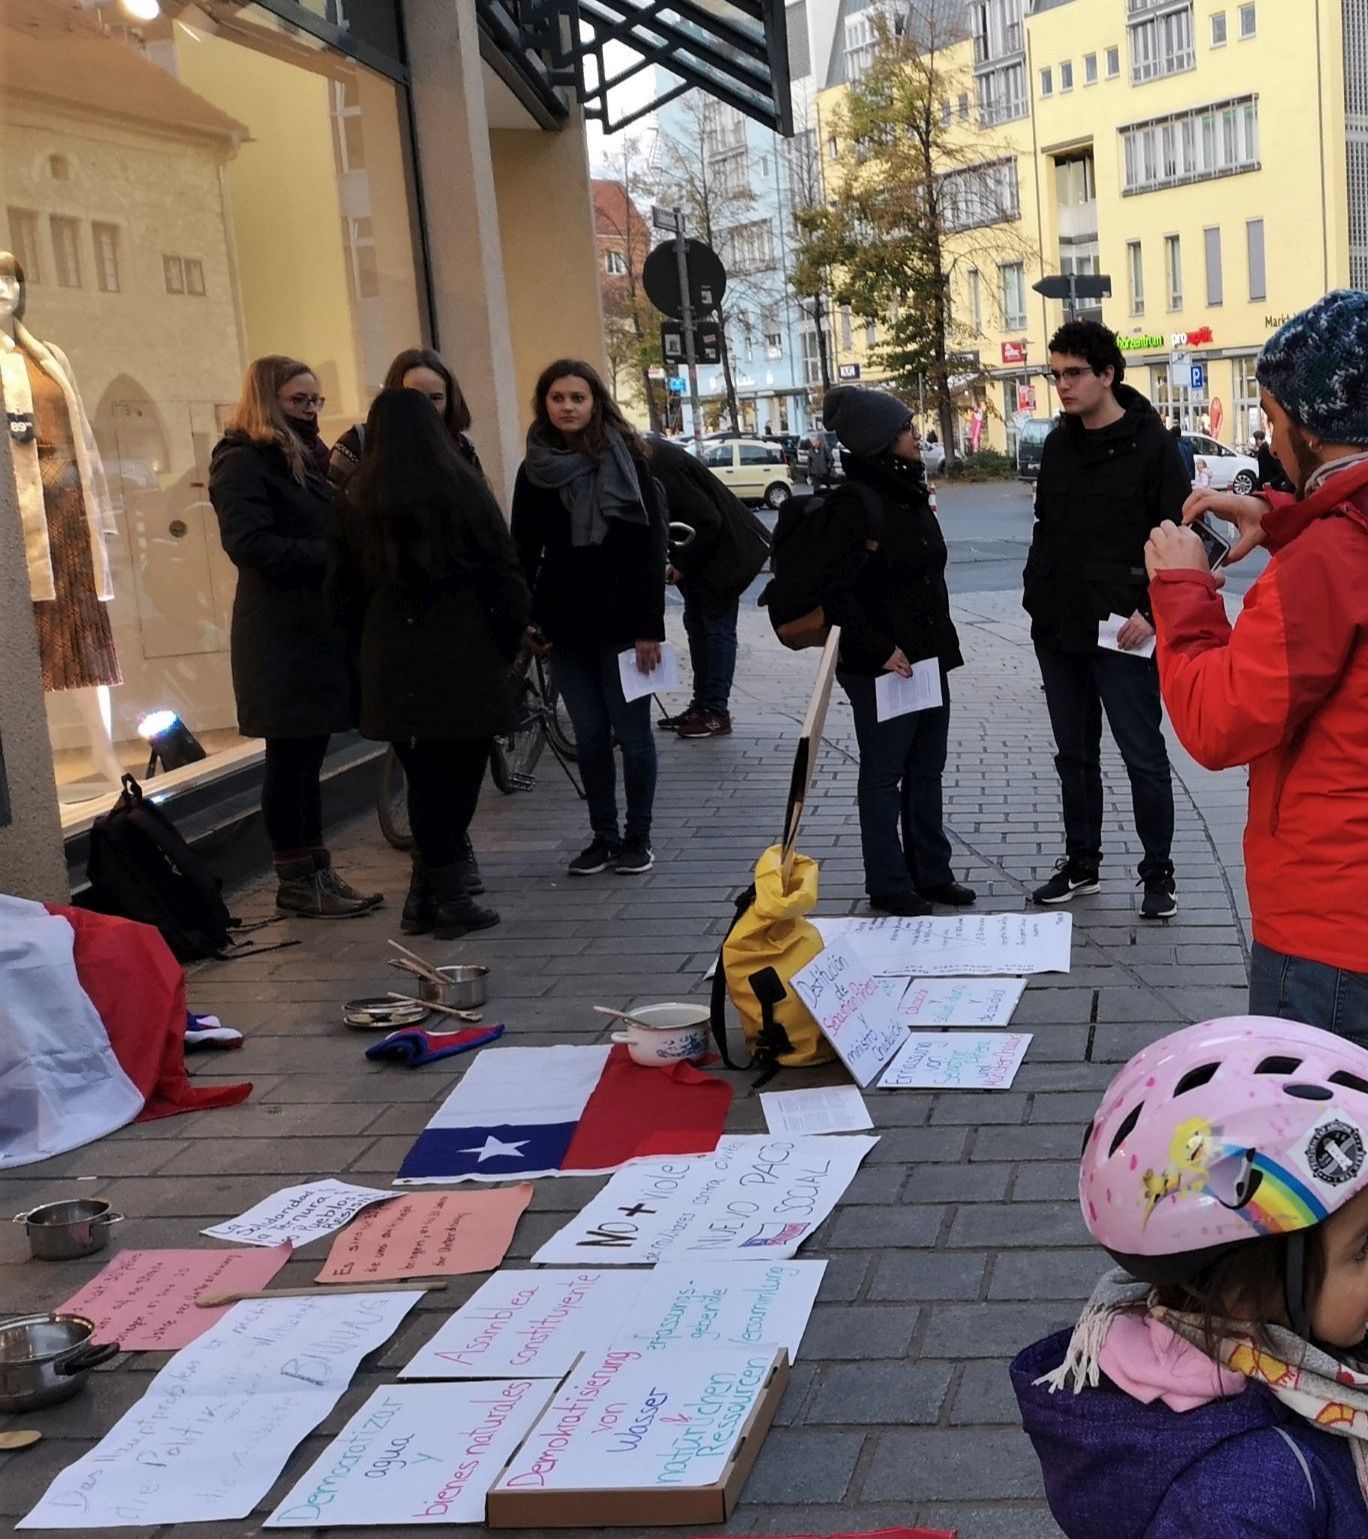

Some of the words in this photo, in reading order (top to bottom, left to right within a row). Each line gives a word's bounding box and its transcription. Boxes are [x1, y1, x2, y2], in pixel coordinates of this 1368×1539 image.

[1192, 367, 1201, 386] P
[834, 982, 849, 1001] de
[773, 1160, 831, 1216] SOCIAL
[576, 1221, 640, 1248] NO
[685, 1200, 760, 1252] NUEVO
[333, 1261, 354, 1276] Es
[434, 1285, 541, 1366] Asamblea
[509, 1271, 602, 1367] constituyente
[634, 1278, 697, 1353] erfassungs-
[689, 1286, 729, 1341] gebende
[507, 1347, 642, 1488] Demokratisierung
[590, 1401, 628, 1434] von
[606, 1386, 669, 1454] Wasser
[655, 1372, 738, 1485] natürlichen
[694, 1356, 770, 1459] Ressourcen
[277, 1395, 405, 1522] Democratizar
[364, 1431, 416, 1480] agua
[411, 1451, 445, 1465] y
[412, 1458, 481, 1519] bienes
[456, 1381, 533, 1456] naturales
